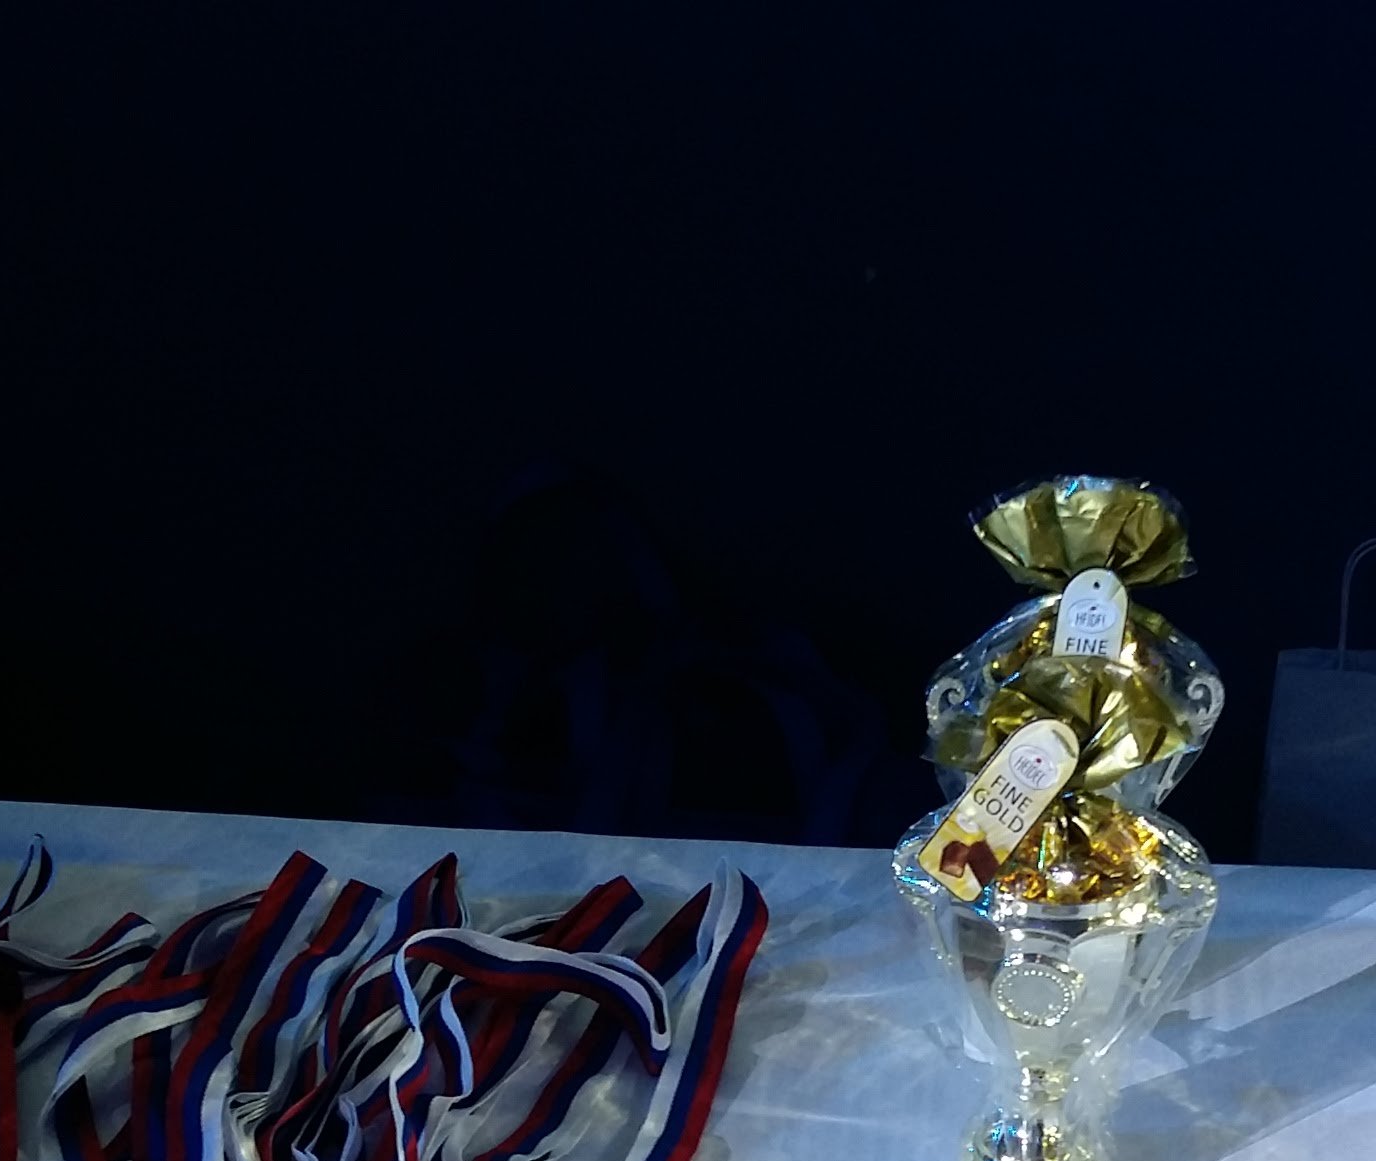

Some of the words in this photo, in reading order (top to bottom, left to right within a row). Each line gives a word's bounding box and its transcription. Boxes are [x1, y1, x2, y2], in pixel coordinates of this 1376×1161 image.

[1065, 636, 1108, 655] FINE
[973, 788, 1024, 833] GOLD
[990, 774, 1033, 814] FINE
